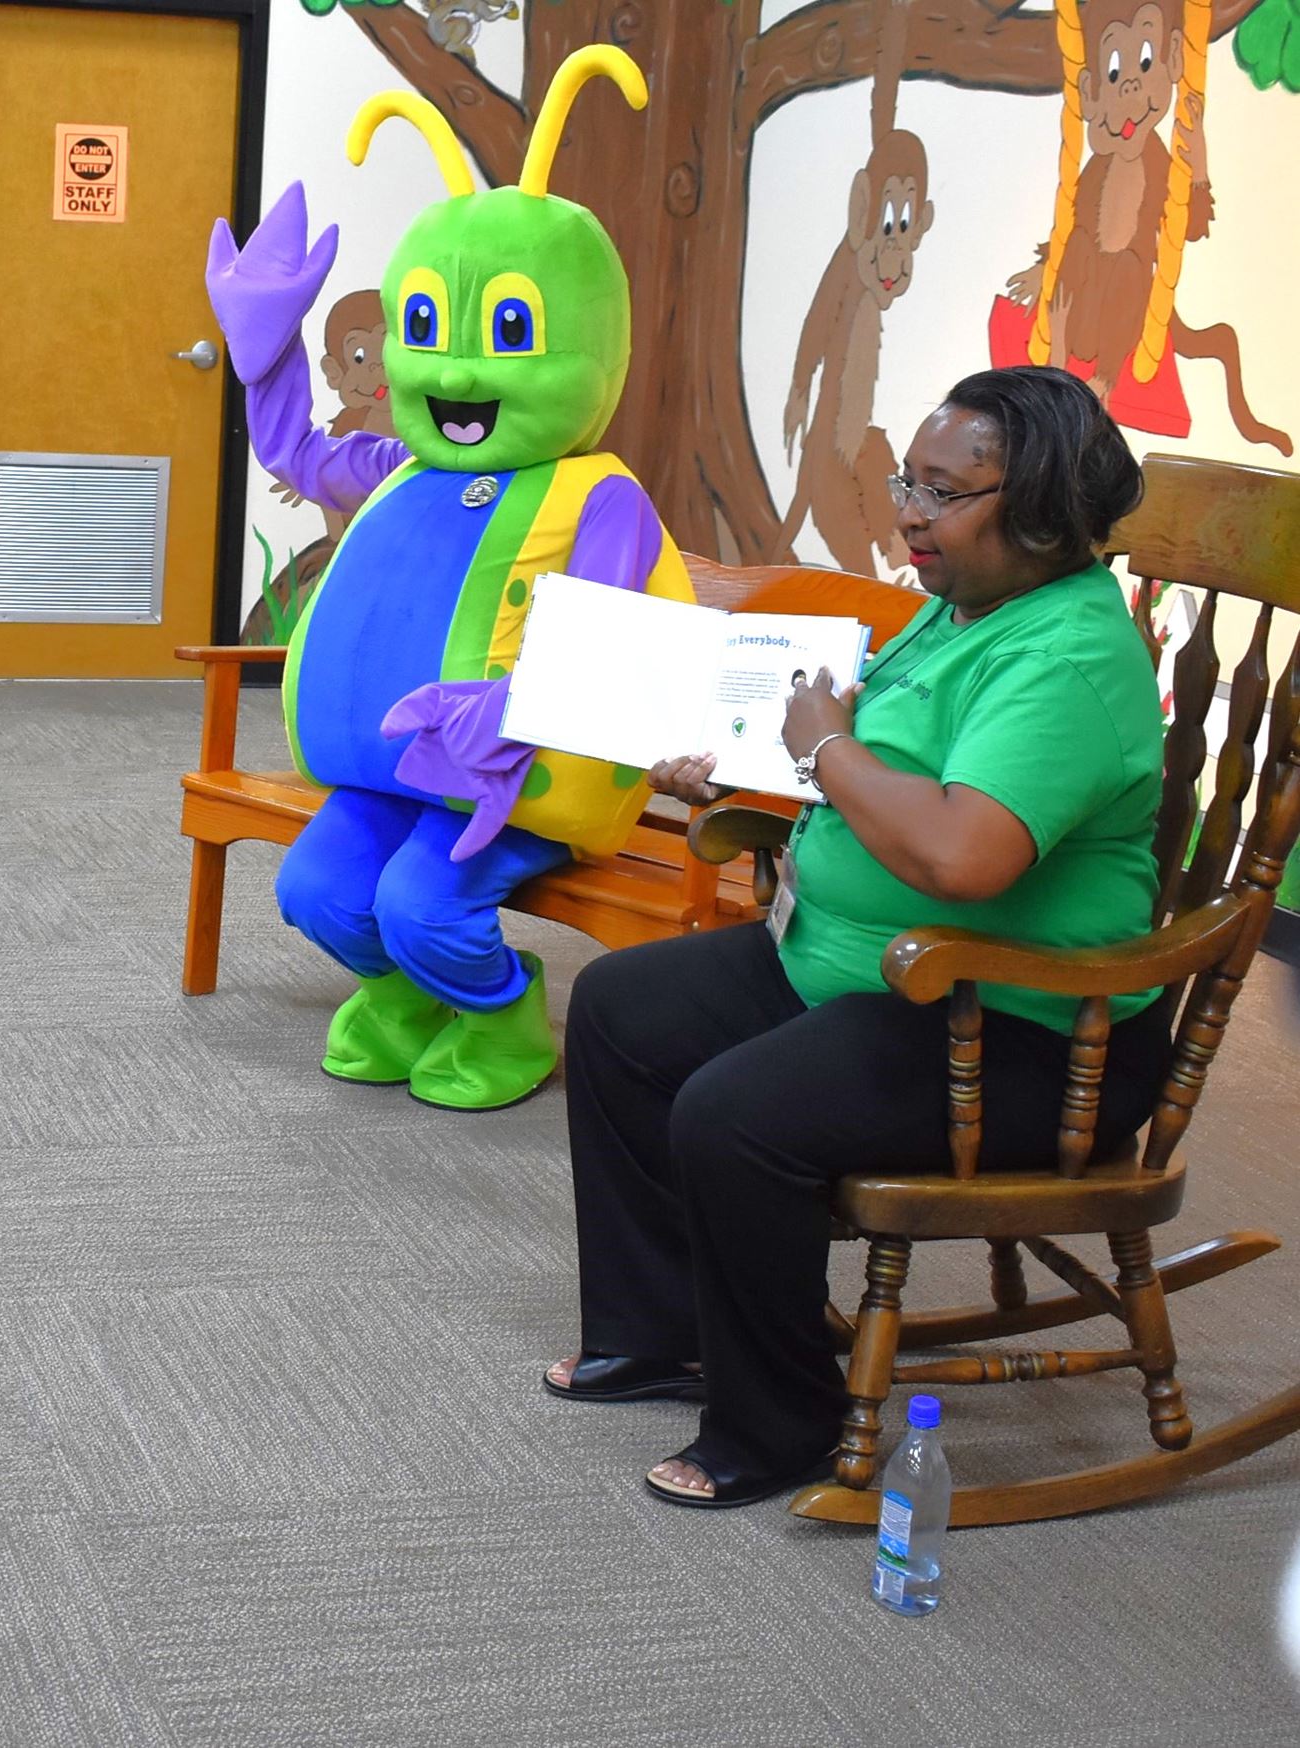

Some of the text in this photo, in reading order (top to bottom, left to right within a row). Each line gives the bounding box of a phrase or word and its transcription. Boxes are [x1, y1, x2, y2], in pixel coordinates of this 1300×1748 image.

[73, 145, 109, 155] DO NOT
[74, 163, 106, 173] ENTER
[65, 186, 115, 199] STAFF
[68, 199, 111, 212] ONLY
[739, 634, 791, 648] Everybody
